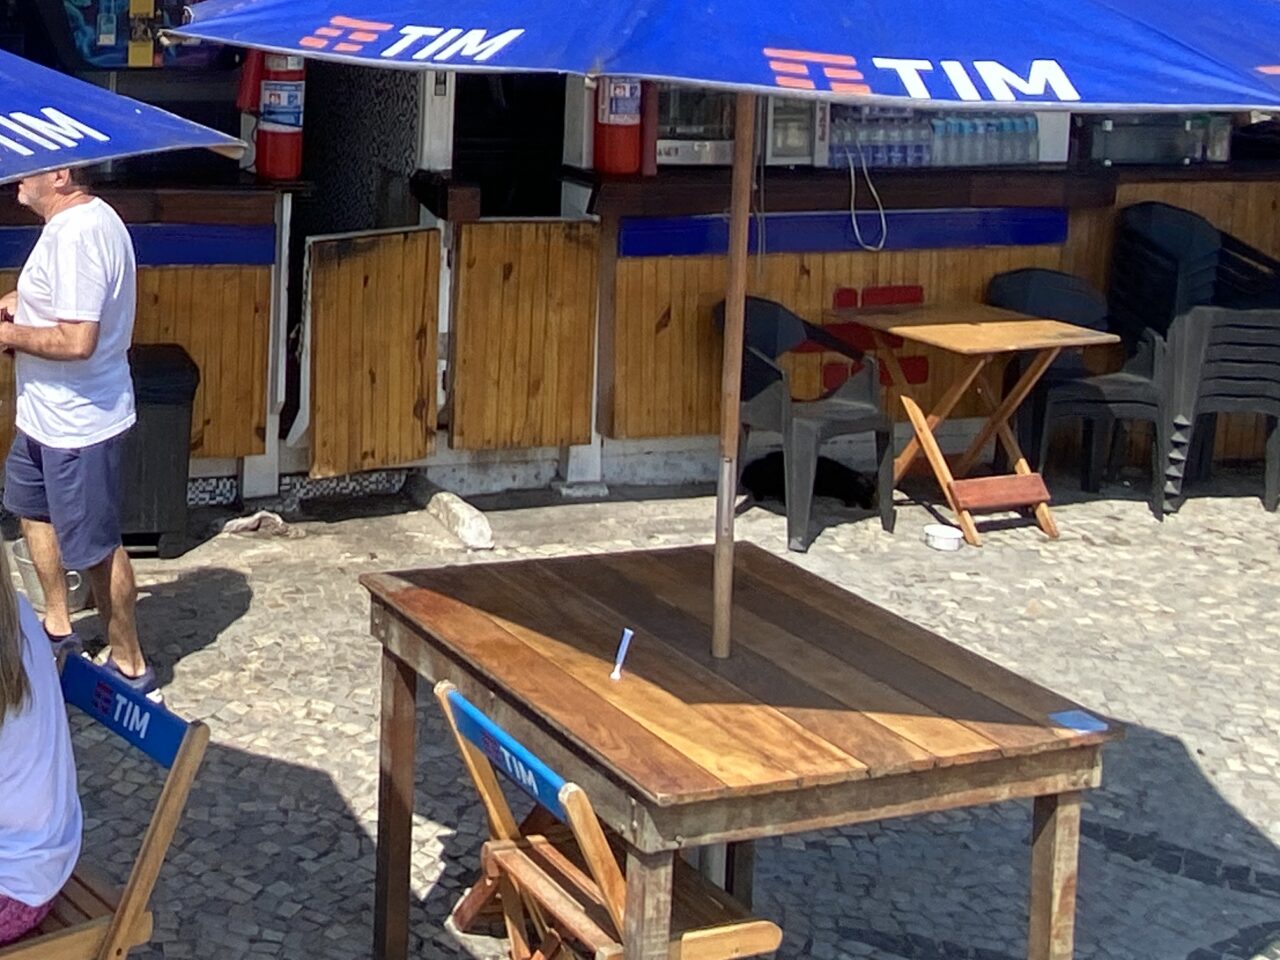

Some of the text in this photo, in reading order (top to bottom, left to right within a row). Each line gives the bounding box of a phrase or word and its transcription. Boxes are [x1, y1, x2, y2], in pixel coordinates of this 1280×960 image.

[380, 24, 527, 62] TIM
[871, 57, 1082, 102] TIM
[113, 693, 151, 739] TIM
[499, 745, 540, 797] TIM
